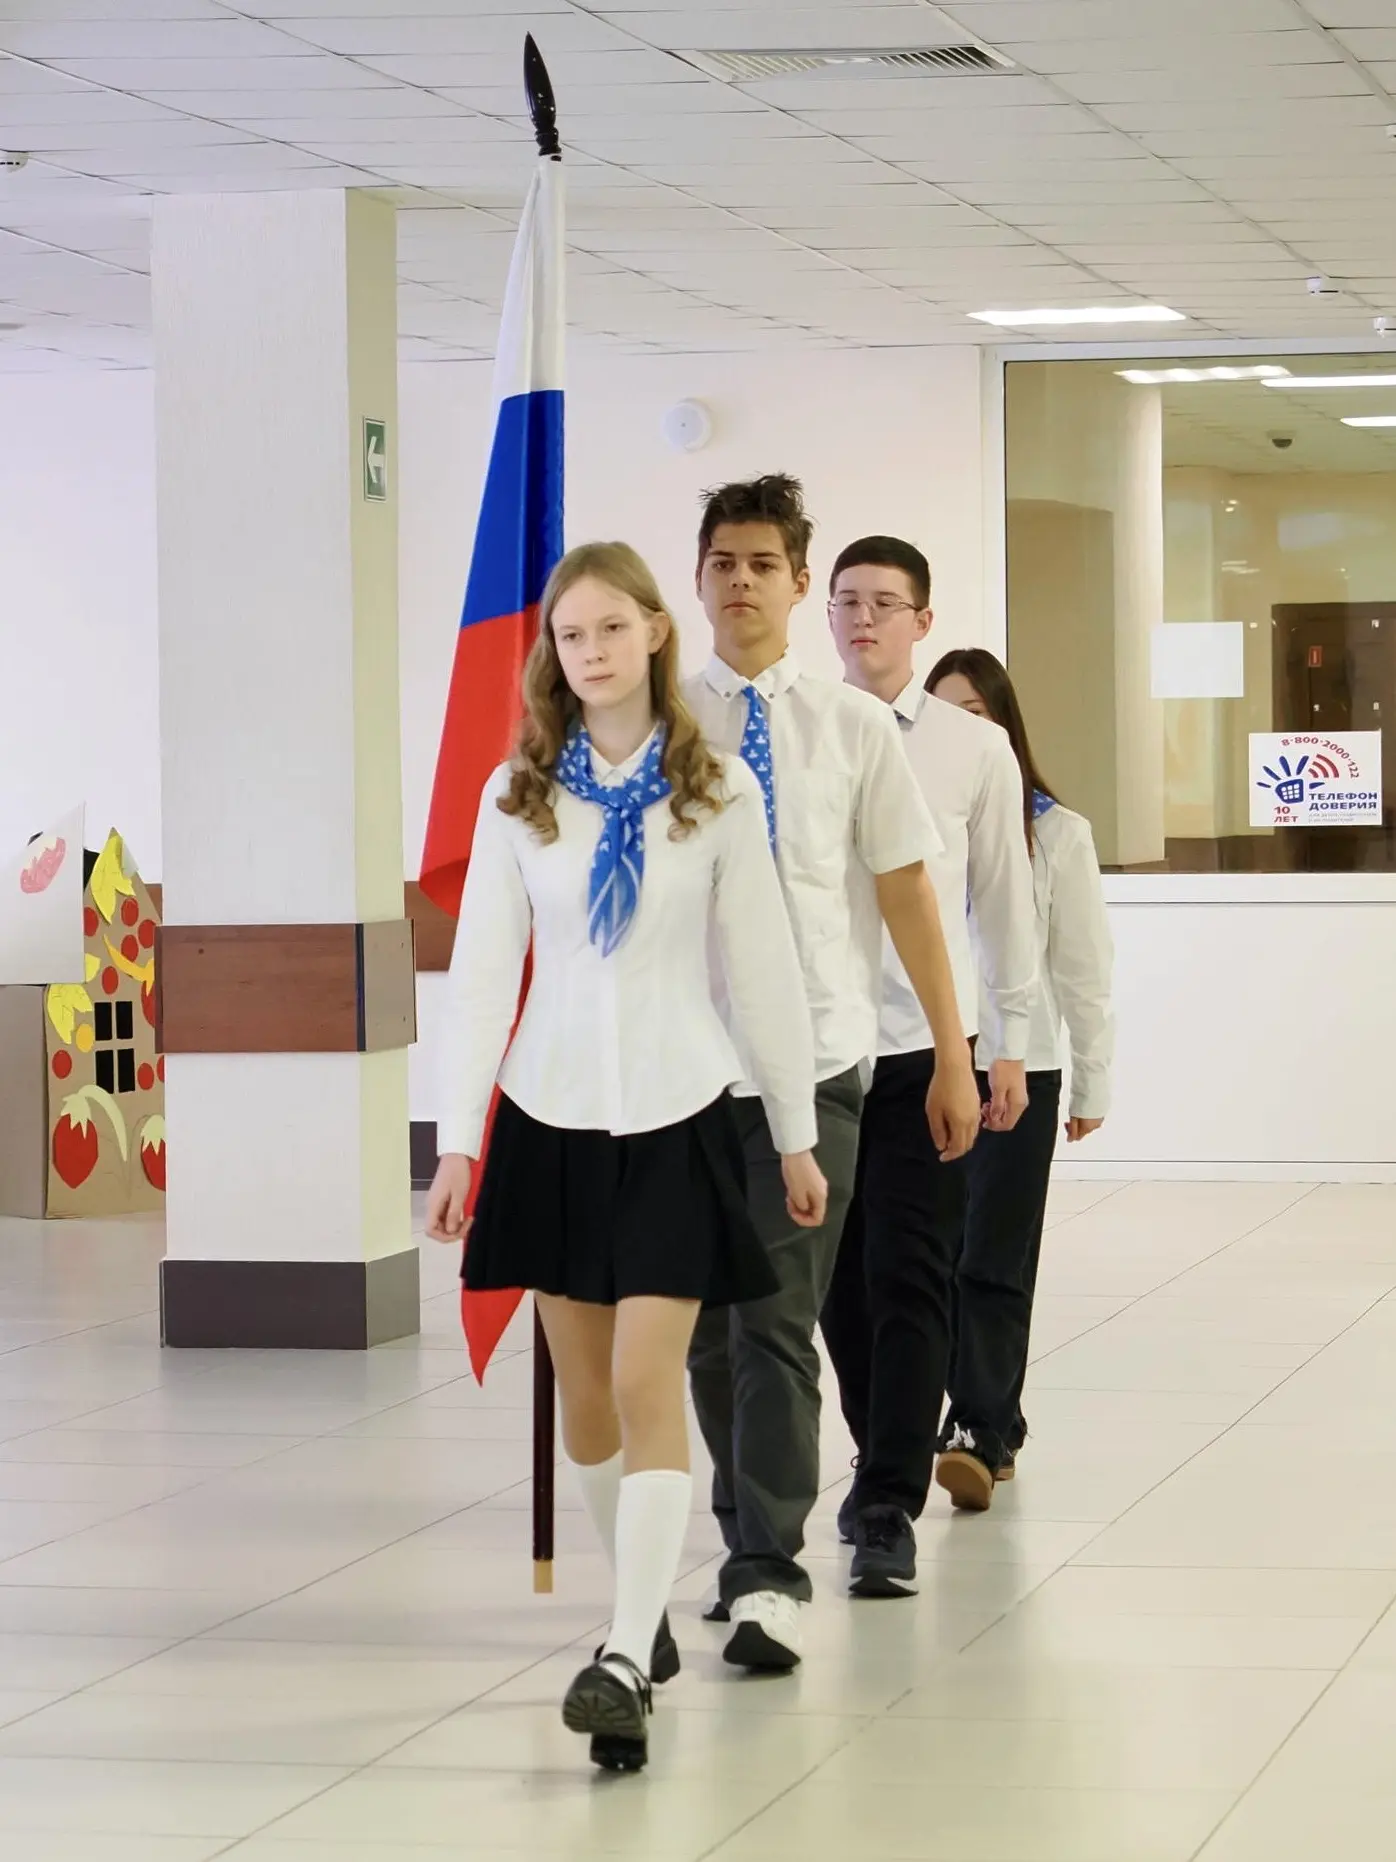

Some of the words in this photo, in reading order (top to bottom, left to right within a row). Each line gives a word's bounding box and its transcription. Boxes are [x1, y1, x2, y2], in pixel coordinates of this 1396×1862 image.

[1309, 792, 1378, 801] ТЕЛЕФОН
[1274, 806, 1290, 814] 10
[1309, 802, 1377, 811] ДОВЕРИЯ
[1273, 815, 1298, 823] ЛЕТ
